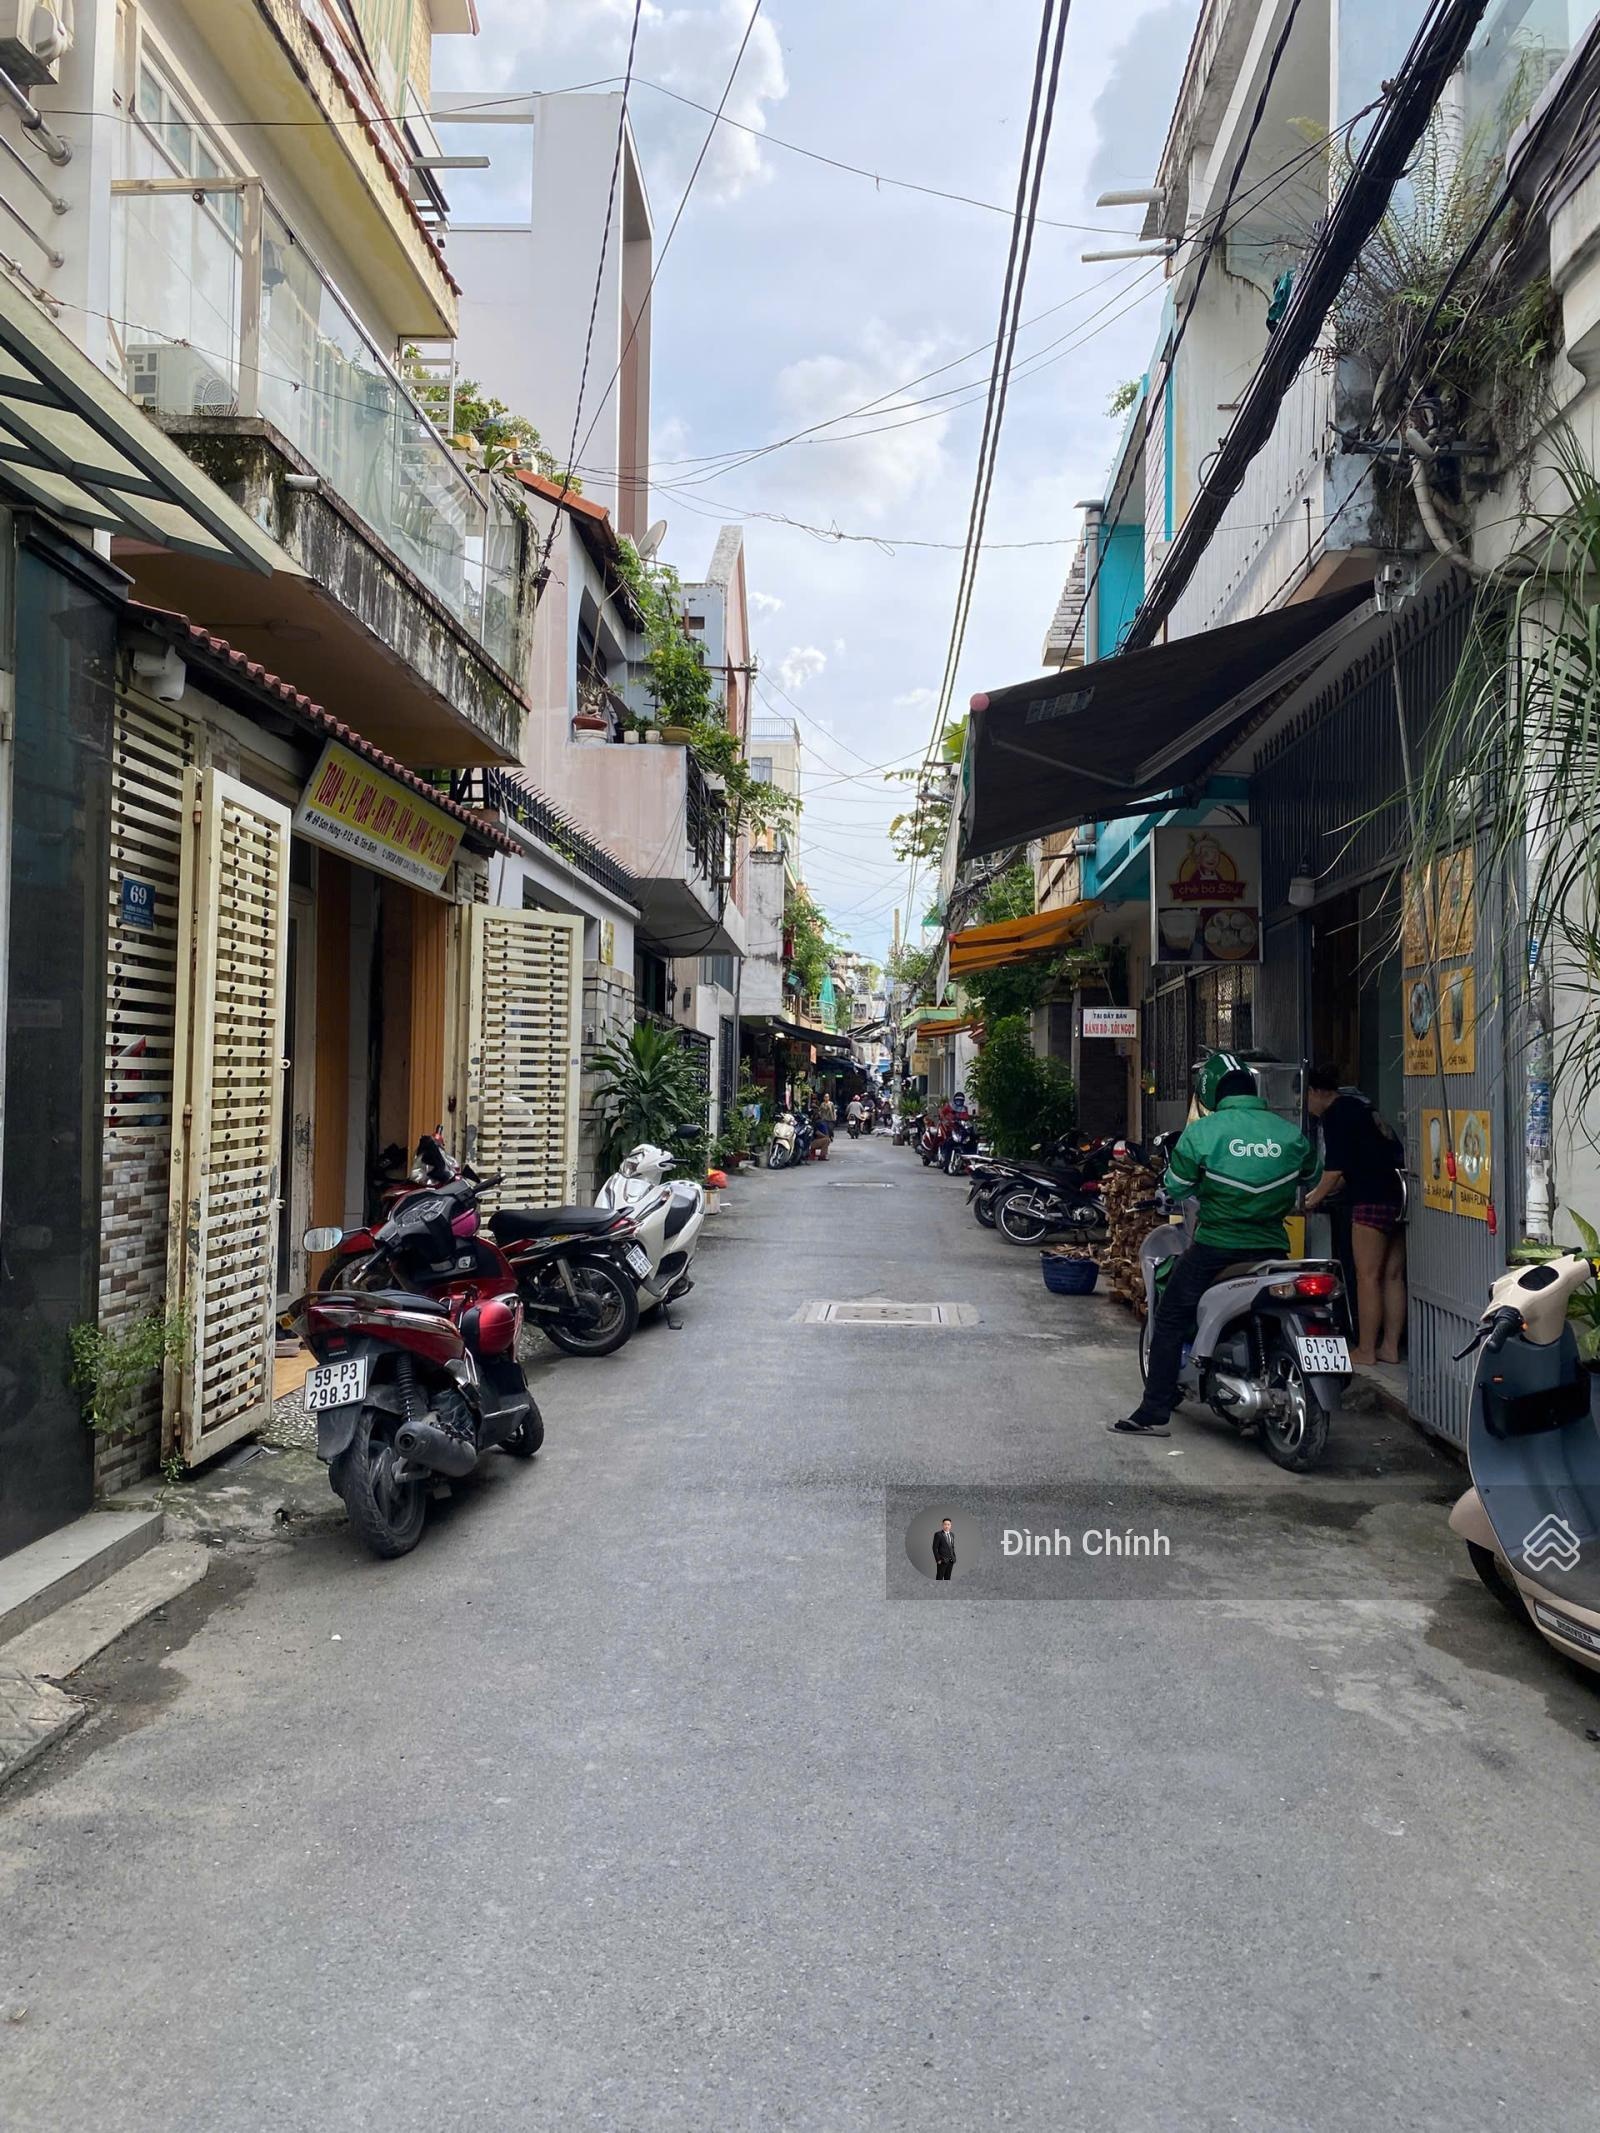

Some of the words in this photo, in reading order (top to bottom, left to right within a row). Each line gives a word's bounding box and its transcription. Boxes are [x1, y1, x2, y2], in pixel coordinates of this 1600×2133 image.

[130, 885, 147, 905] 69
[1229, 1138, 1282, 1158] Grab
[1305, 1339, 1339, 1354] 61-G1
[1304, 1355, 1347, 1370] 913.47
[315, 1362, 358, 1388] 59-P3
[309, 1380, 360, 1409] 298.31
